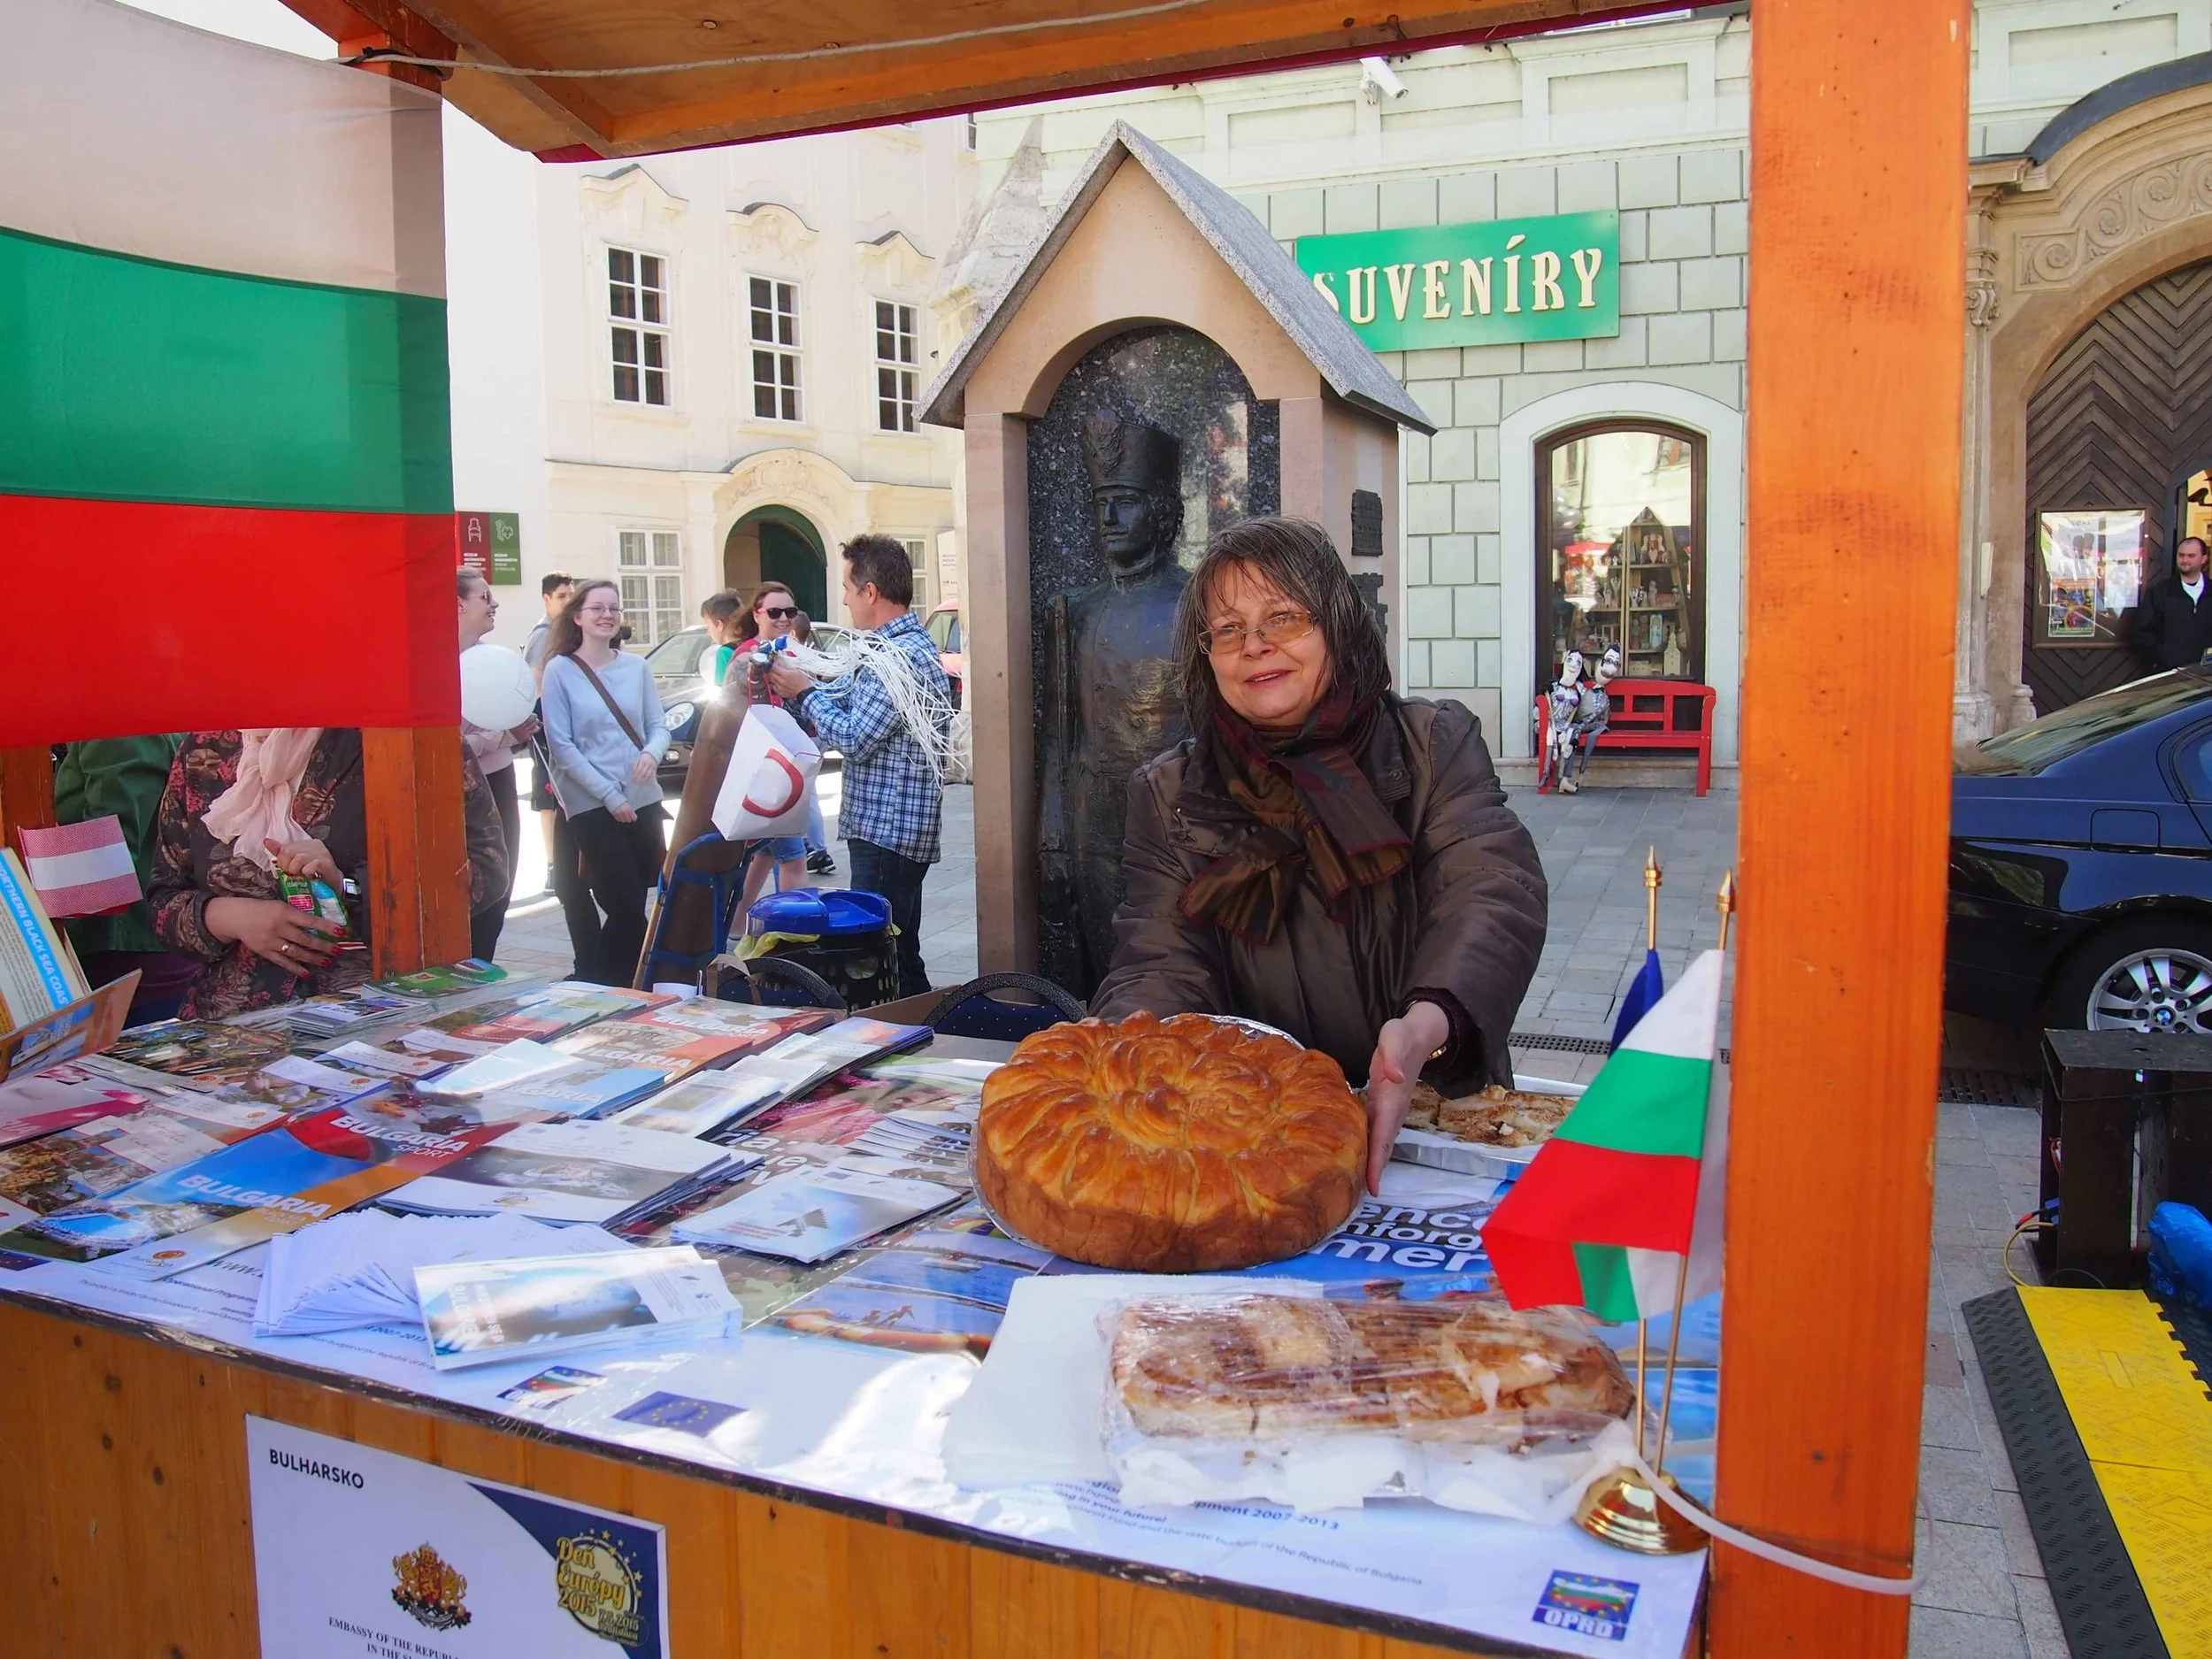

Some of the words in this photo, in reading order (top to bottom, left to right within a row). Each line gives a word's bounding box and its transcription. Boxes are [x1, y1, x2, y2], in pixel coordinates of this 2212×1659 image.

[23, 917, 46, 952] BLACK
[39, 952, 55, 974] SEA
[50, 974, 69, 1005] COAS
[329, 1115, 469, 1151] BULGARIA
[396, 1142, 455, 1159] SPORT
[177, 1174, 333, 1217] BULGARIA
[269, 1448, 365, 1489] BULHARSKO
[1252, 1509, 1340, 1530] 2007-2013
[1275, 1545, 1296, 1556] the
[557, 1563, 626, 1610] Európy
[558, 1586, 597, 1617] 2015
[328, 1617, 373, 1639] EMBASSY
[376, 1632, 390, 1643] OF
[391, 1636, 412, 1651] THE
[1544, 1608, 1614, 1637] OPRD
[367, 1643, 378, 1654] IN
[380, 1647, 401, 1659] THE
